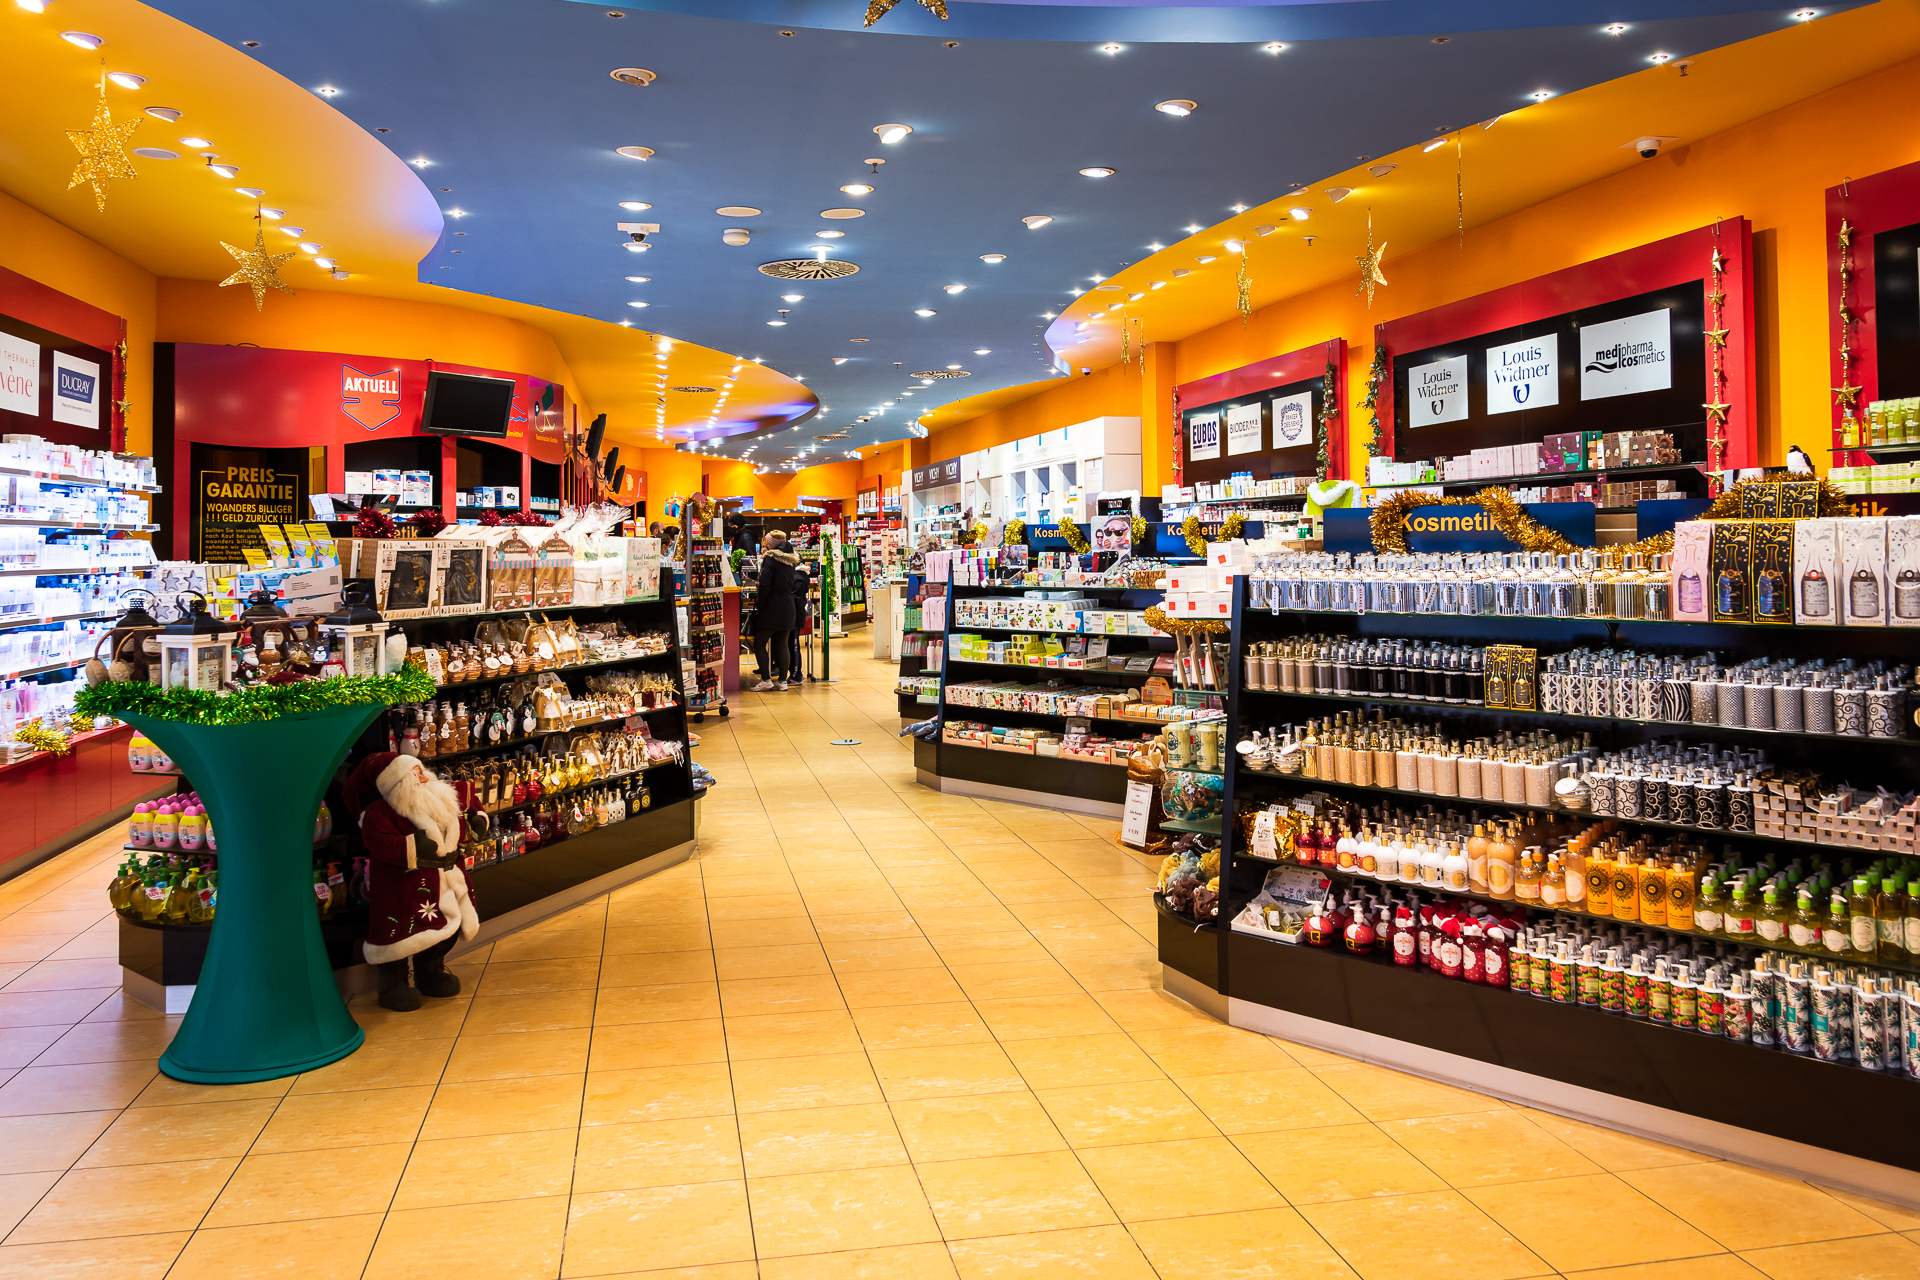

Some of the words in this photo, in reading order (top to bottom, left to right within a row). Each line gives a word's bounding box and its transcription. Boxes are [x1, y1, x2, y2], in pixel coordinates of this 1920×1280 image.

[4, 350, 35, 368] THERMALE
[1503, 346, 1542, 366] Louis
[1621, 349, 1666, 368] cosmetics
[0, 366, 32, 398] vène
[1423, 368, 1452, 385] Louis
[1494, 364, 1550, 384] Widmer
[62, 374, 90, 394] DUCRAY
[344, 376, 398, 394] AKTUELL
[1418, 382, 1458, 398] Widmer
[1192, 420, 1216, 444] EUBOS
[227, 466, 275, 482] PREIS
[914, 471, 924, 483] VICHY
[928, 466, 940, 480] VICHY
[945, 462, 958, 476] VICHY
[206, 482, 293, 500] GARANTIE
[206, 503, 256, 513] WOANDERS
[259, 504, 292, 514] BILLIGER
[222, 514, 243, 522] GELD
[246, 512, 278, 523] ZURÜCK
[1401, 512, 1504, 532] Kosmetik
[1034, 528, 1062, 538] Kosm
